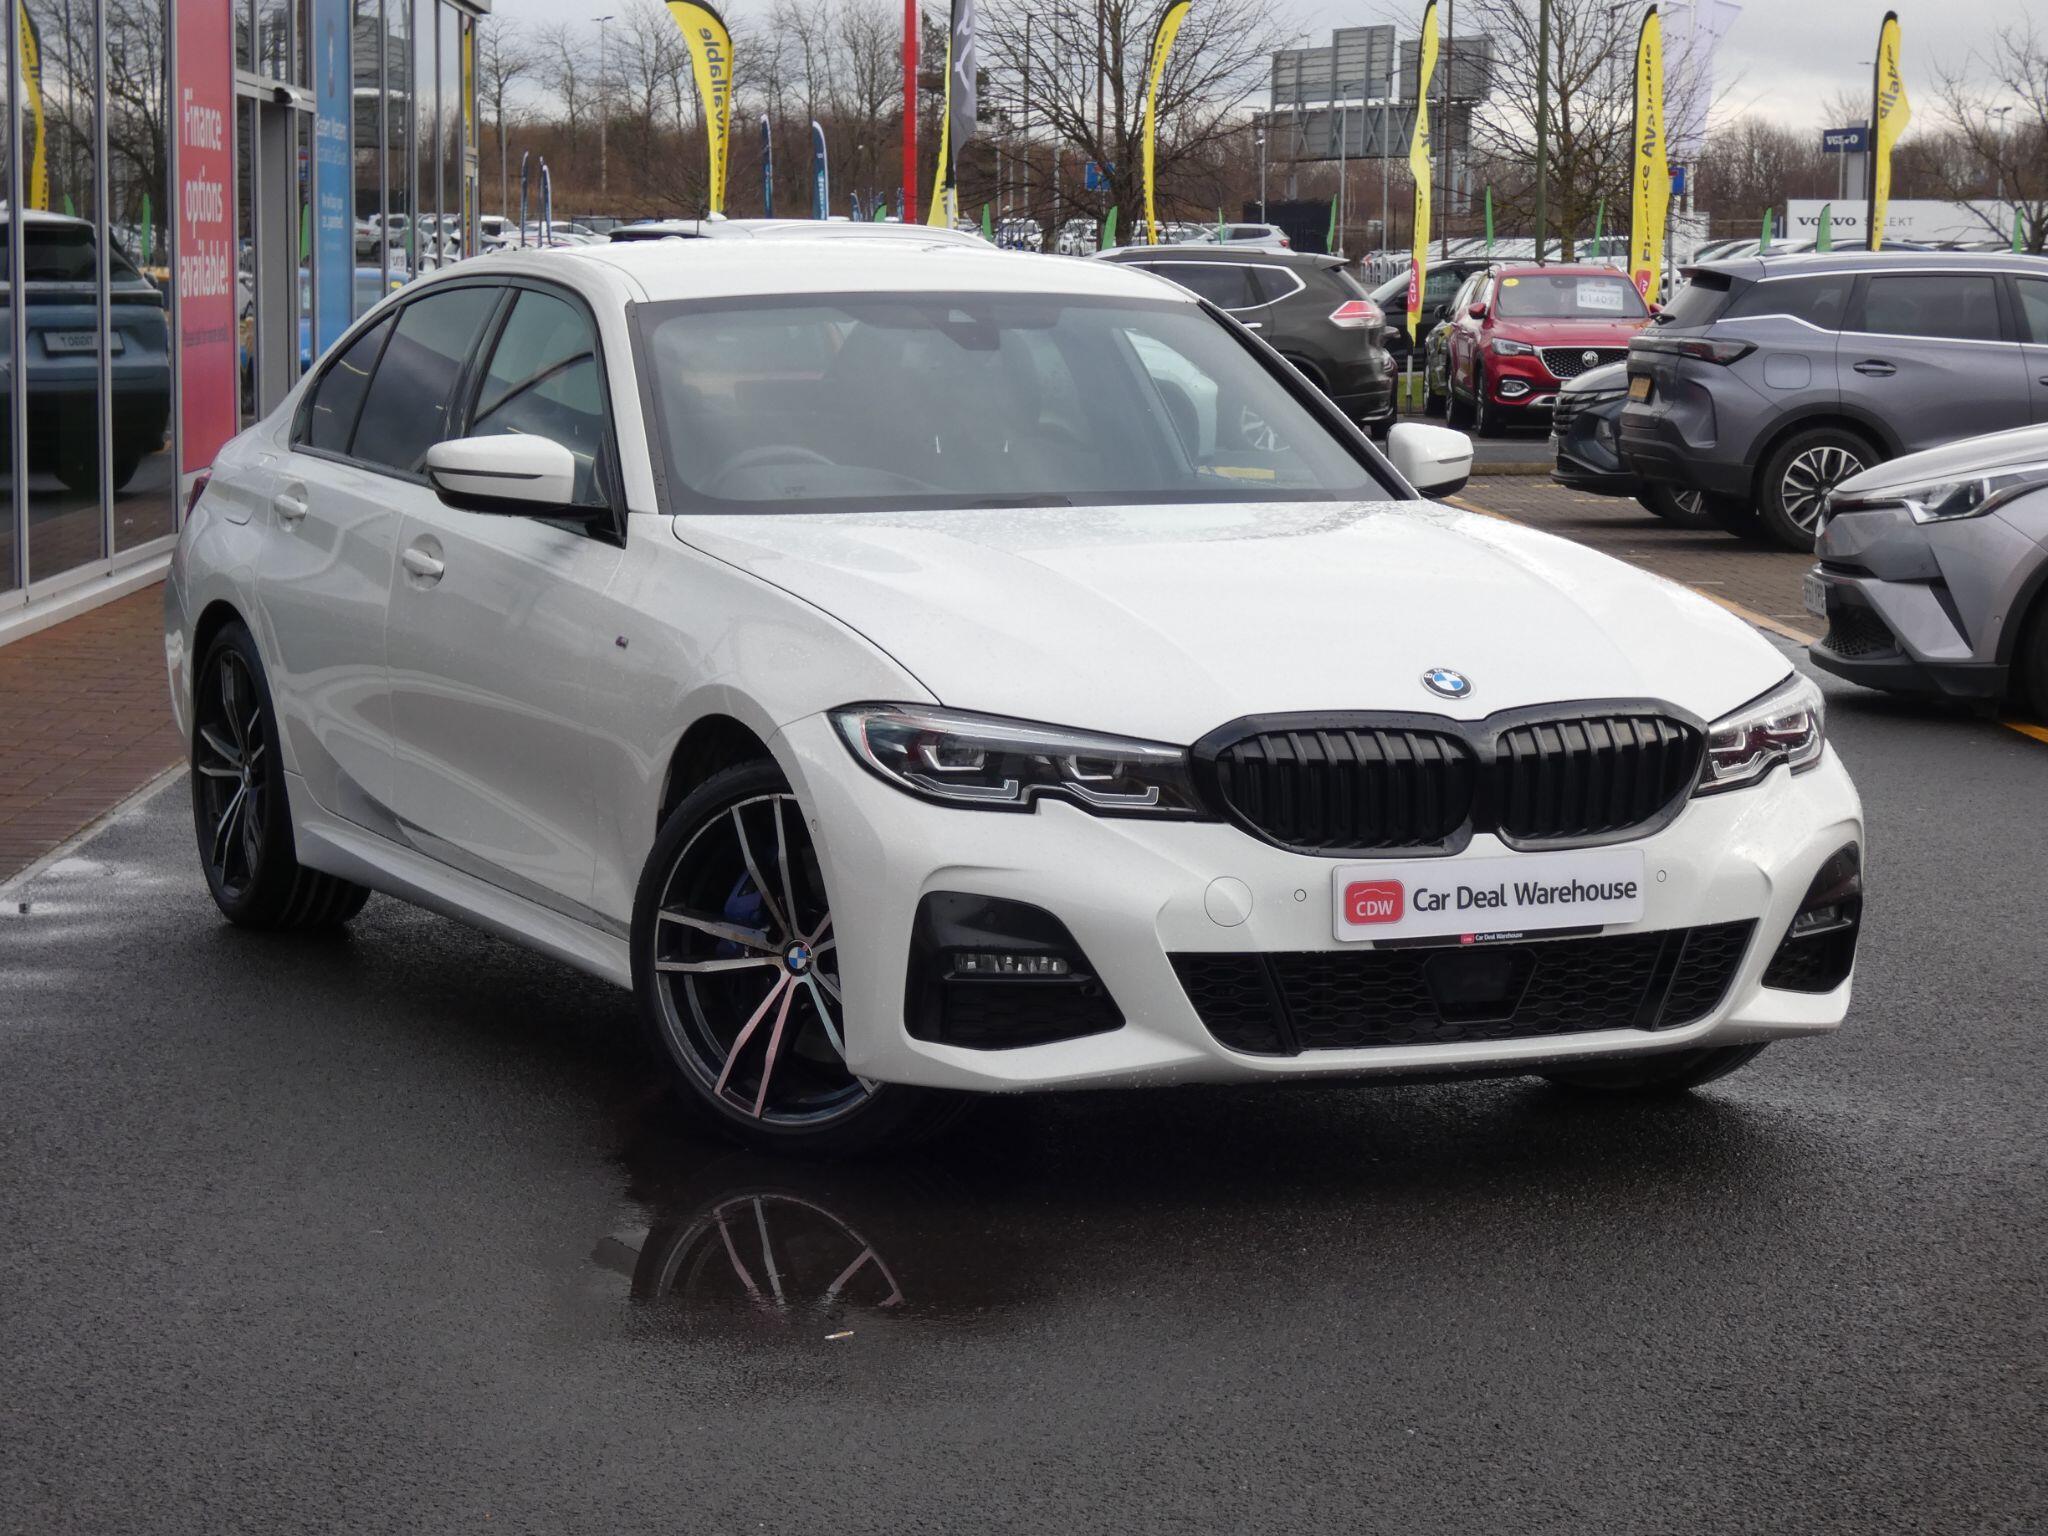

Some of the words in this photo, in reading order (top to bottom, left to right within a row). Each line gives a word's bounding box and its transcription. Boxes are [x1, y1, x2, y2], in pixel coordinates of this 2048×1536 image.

[184, 89, 222, 150] Finance
[186, 166, 223, 239] options
[1642, 165, 1651, 262] Fice
[1798, 217, 1857, 227] VOVO
[1864, 217, 1914, 227] SEKT
[181, 241, 229, 297] available!
[1356, 900, 1393, 916] CDW
[1413, 888, 1450, 912] Car
[1457, 884, 1507, 910] Deal
[1514, 879, 1637, 906] Warehouse
